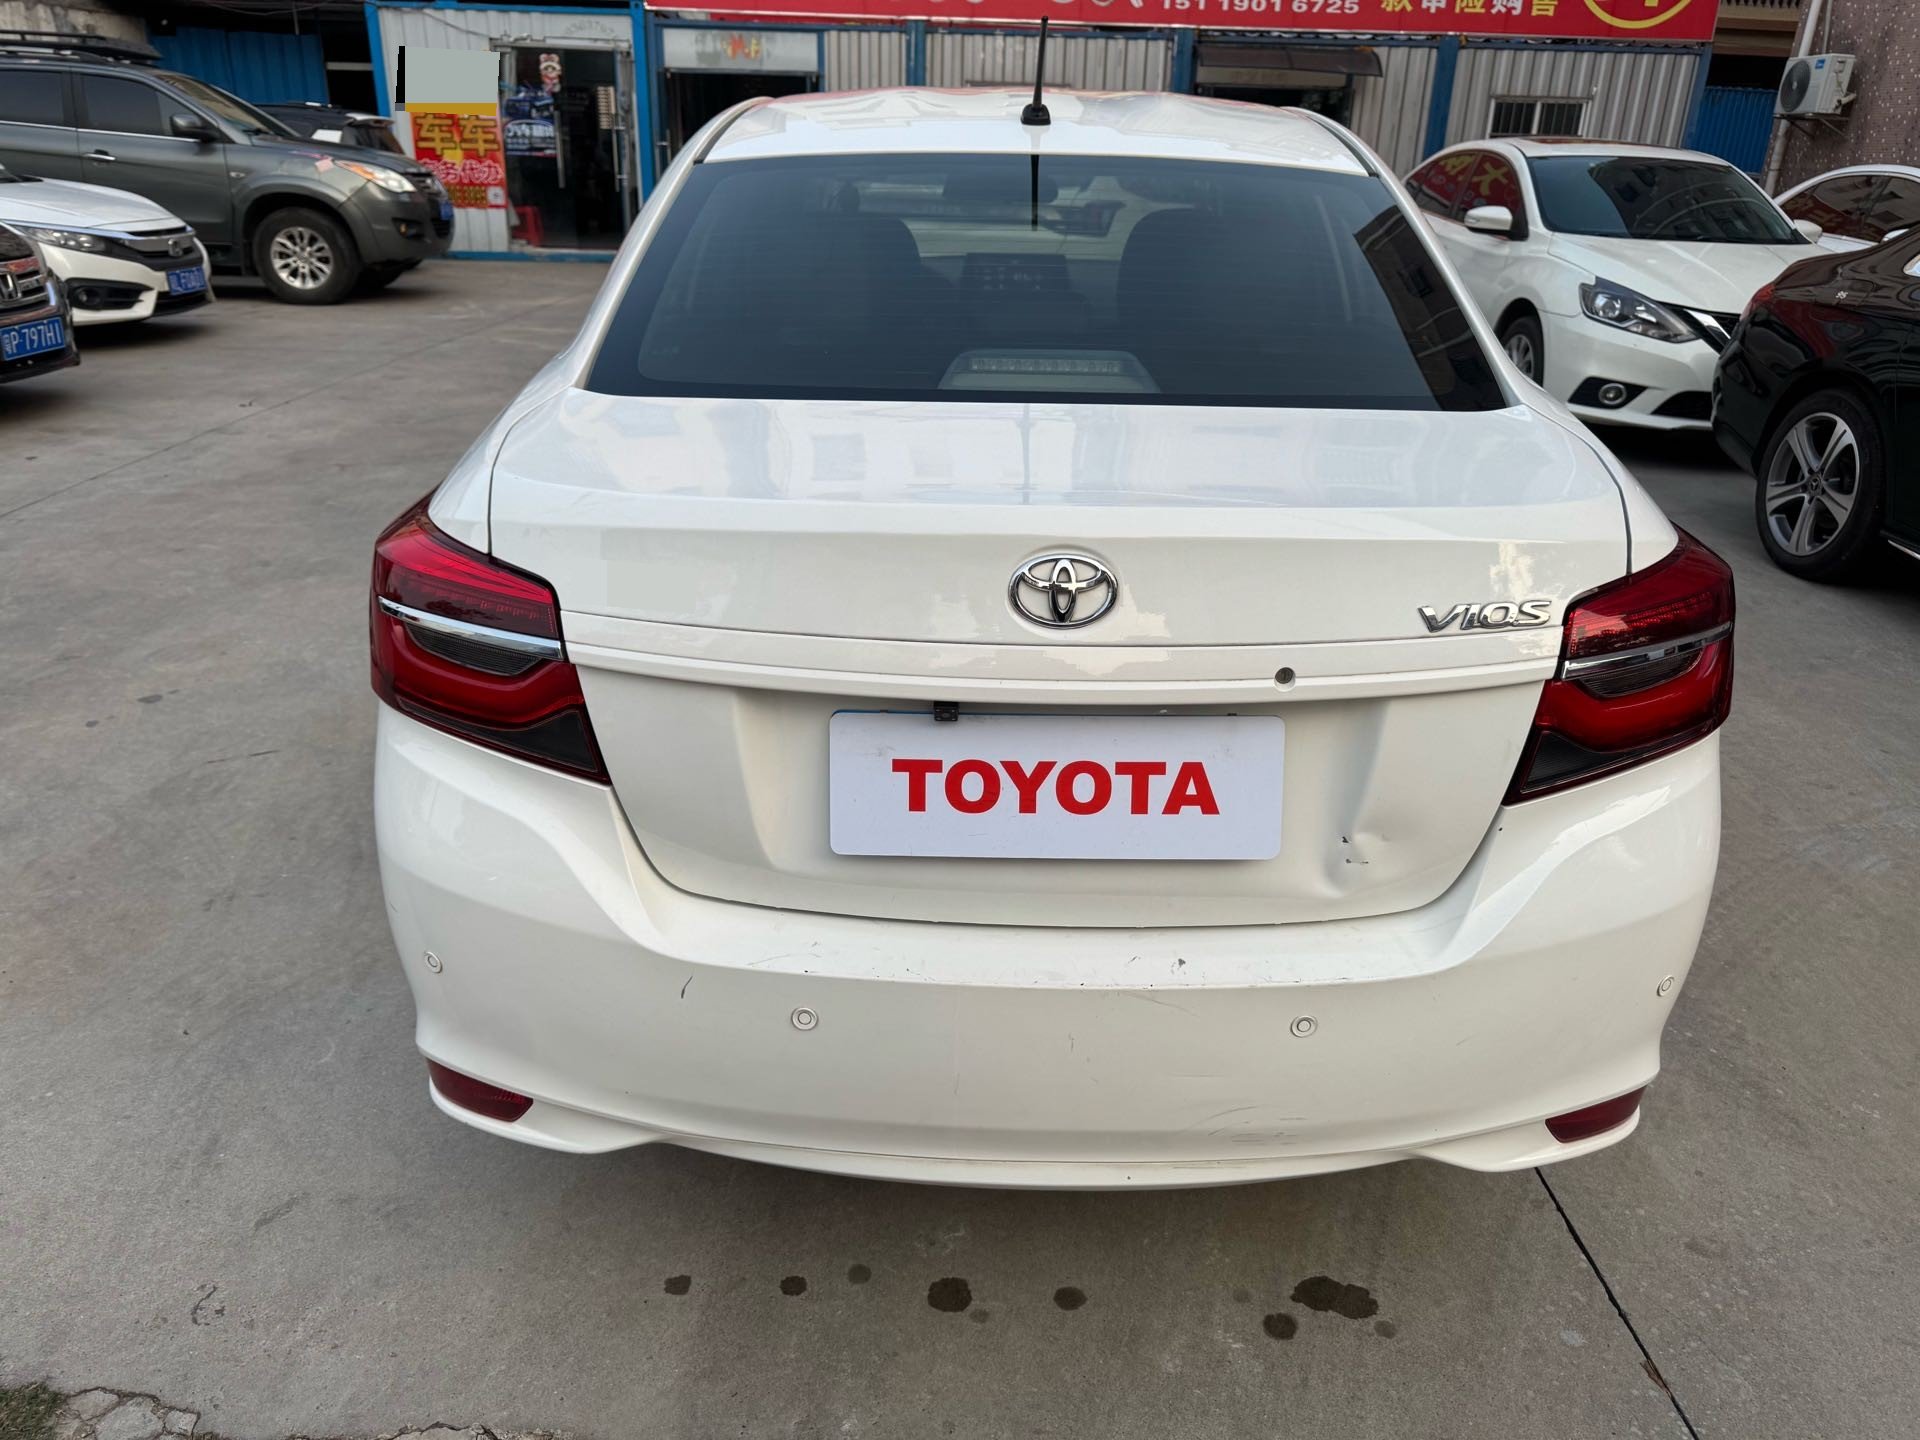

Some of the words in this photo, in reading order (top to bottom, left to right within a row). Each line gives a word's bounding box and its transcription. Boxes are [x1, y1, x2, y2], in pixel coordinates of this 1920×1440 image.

[1218, 0, 1282, 12] 1901
[1292, 0, 1360, 13] 6725
[1418, 600, 1552, 632] VIOS
[892, 758, 1220, 815] TOYOTA
